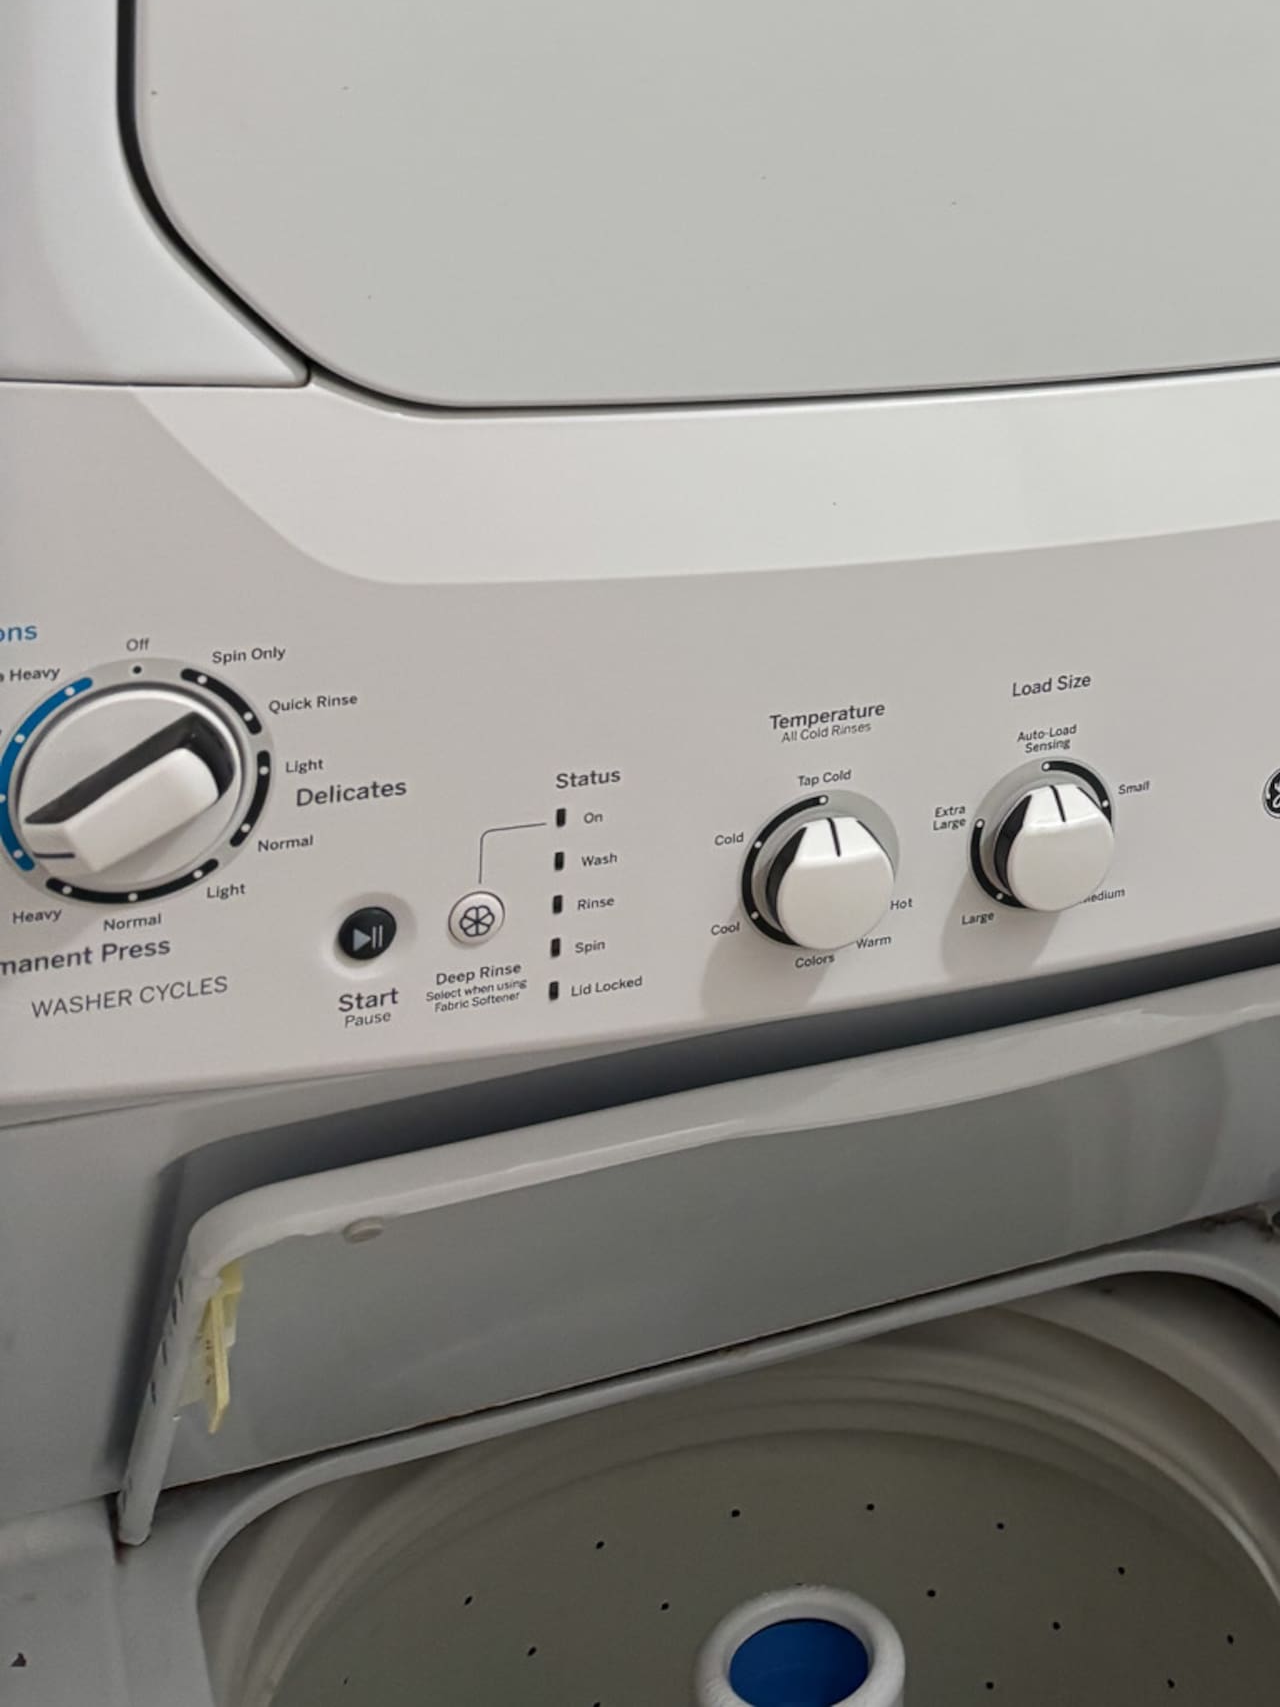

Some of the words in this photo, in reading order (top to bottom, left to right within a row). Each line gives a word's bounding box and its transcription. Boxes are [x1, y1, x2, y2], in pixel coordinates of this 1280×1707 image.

[126, 638, 149, 652] Off
[212, 650, 248, 665] Spin
[252, 646, 286, 662] Only
[9, 668, 60, 682] Heavy
[1012, 678, 1052, 697] Load
[1057, 674, 1091, 691] Size
[269, 697, 312, 714] Quick
[317, 694, 358, 708] Rinse
[769, 702, 885, 730] Temperature
[781, 731, 797, 743] All
[800, 727, 829, 741] Cold
[831, 721, 872, 737] Rinses
[1017, 724, 1077, 742] Auto-Load
[1025, 738, 1071, 754] Sensing
[285, 758, 324, 774] Light
[555, 769, 621, 789] Status
[797, 773, 820, 787] Tap
[823, 769, 852, 784] Cold
[296, 780, 407, 807] Delicates
[1118, 780, 1150, 795] Small
[583, 811, 603, 824] On
[935, 805, 966, 817] Extra
[933, 817, 966, 831] Large
[258, 835, 314, 852] Normal
[714, 832, 745, 846] Cold
[581, 852, 618, 867] Wash
[206, 883, 246, 900] Light
[577, 896, 615, 910] Rinse
[890, 898, 913, 910] Hot
[12, 909, 62, 924] Heavy
[103, 913, 162, 931] Normal
[962, 911, 995, 925] Large
[711, 922, 740, 936] Cool
[574, 940, 606, 954] Spin
[856, 935, 892, 949] Warm
[101, 940, 171, 962] Press
[795, 954, 835, 969] Colors
[436, 971, 476, 986] Deep
[480, 963, 522, 979] Rinse
[425, 988, 462, 1002] Select
[464, 984, 494, 996] when
[496, 979, 527, 991] using
[570, 982, 592, 997] Lid
[595, 976, 643, 995] Locked
[31, 989, 133, 1018] WASHER
[139, 976, 228, 1004] CYCLES
[338, 987, 399, 1012] Start
[434, 1000, 469, 1013] Fabric
[471, 991, 520, 1007] Softener
[344, 1011, 391, 1028] Pause
